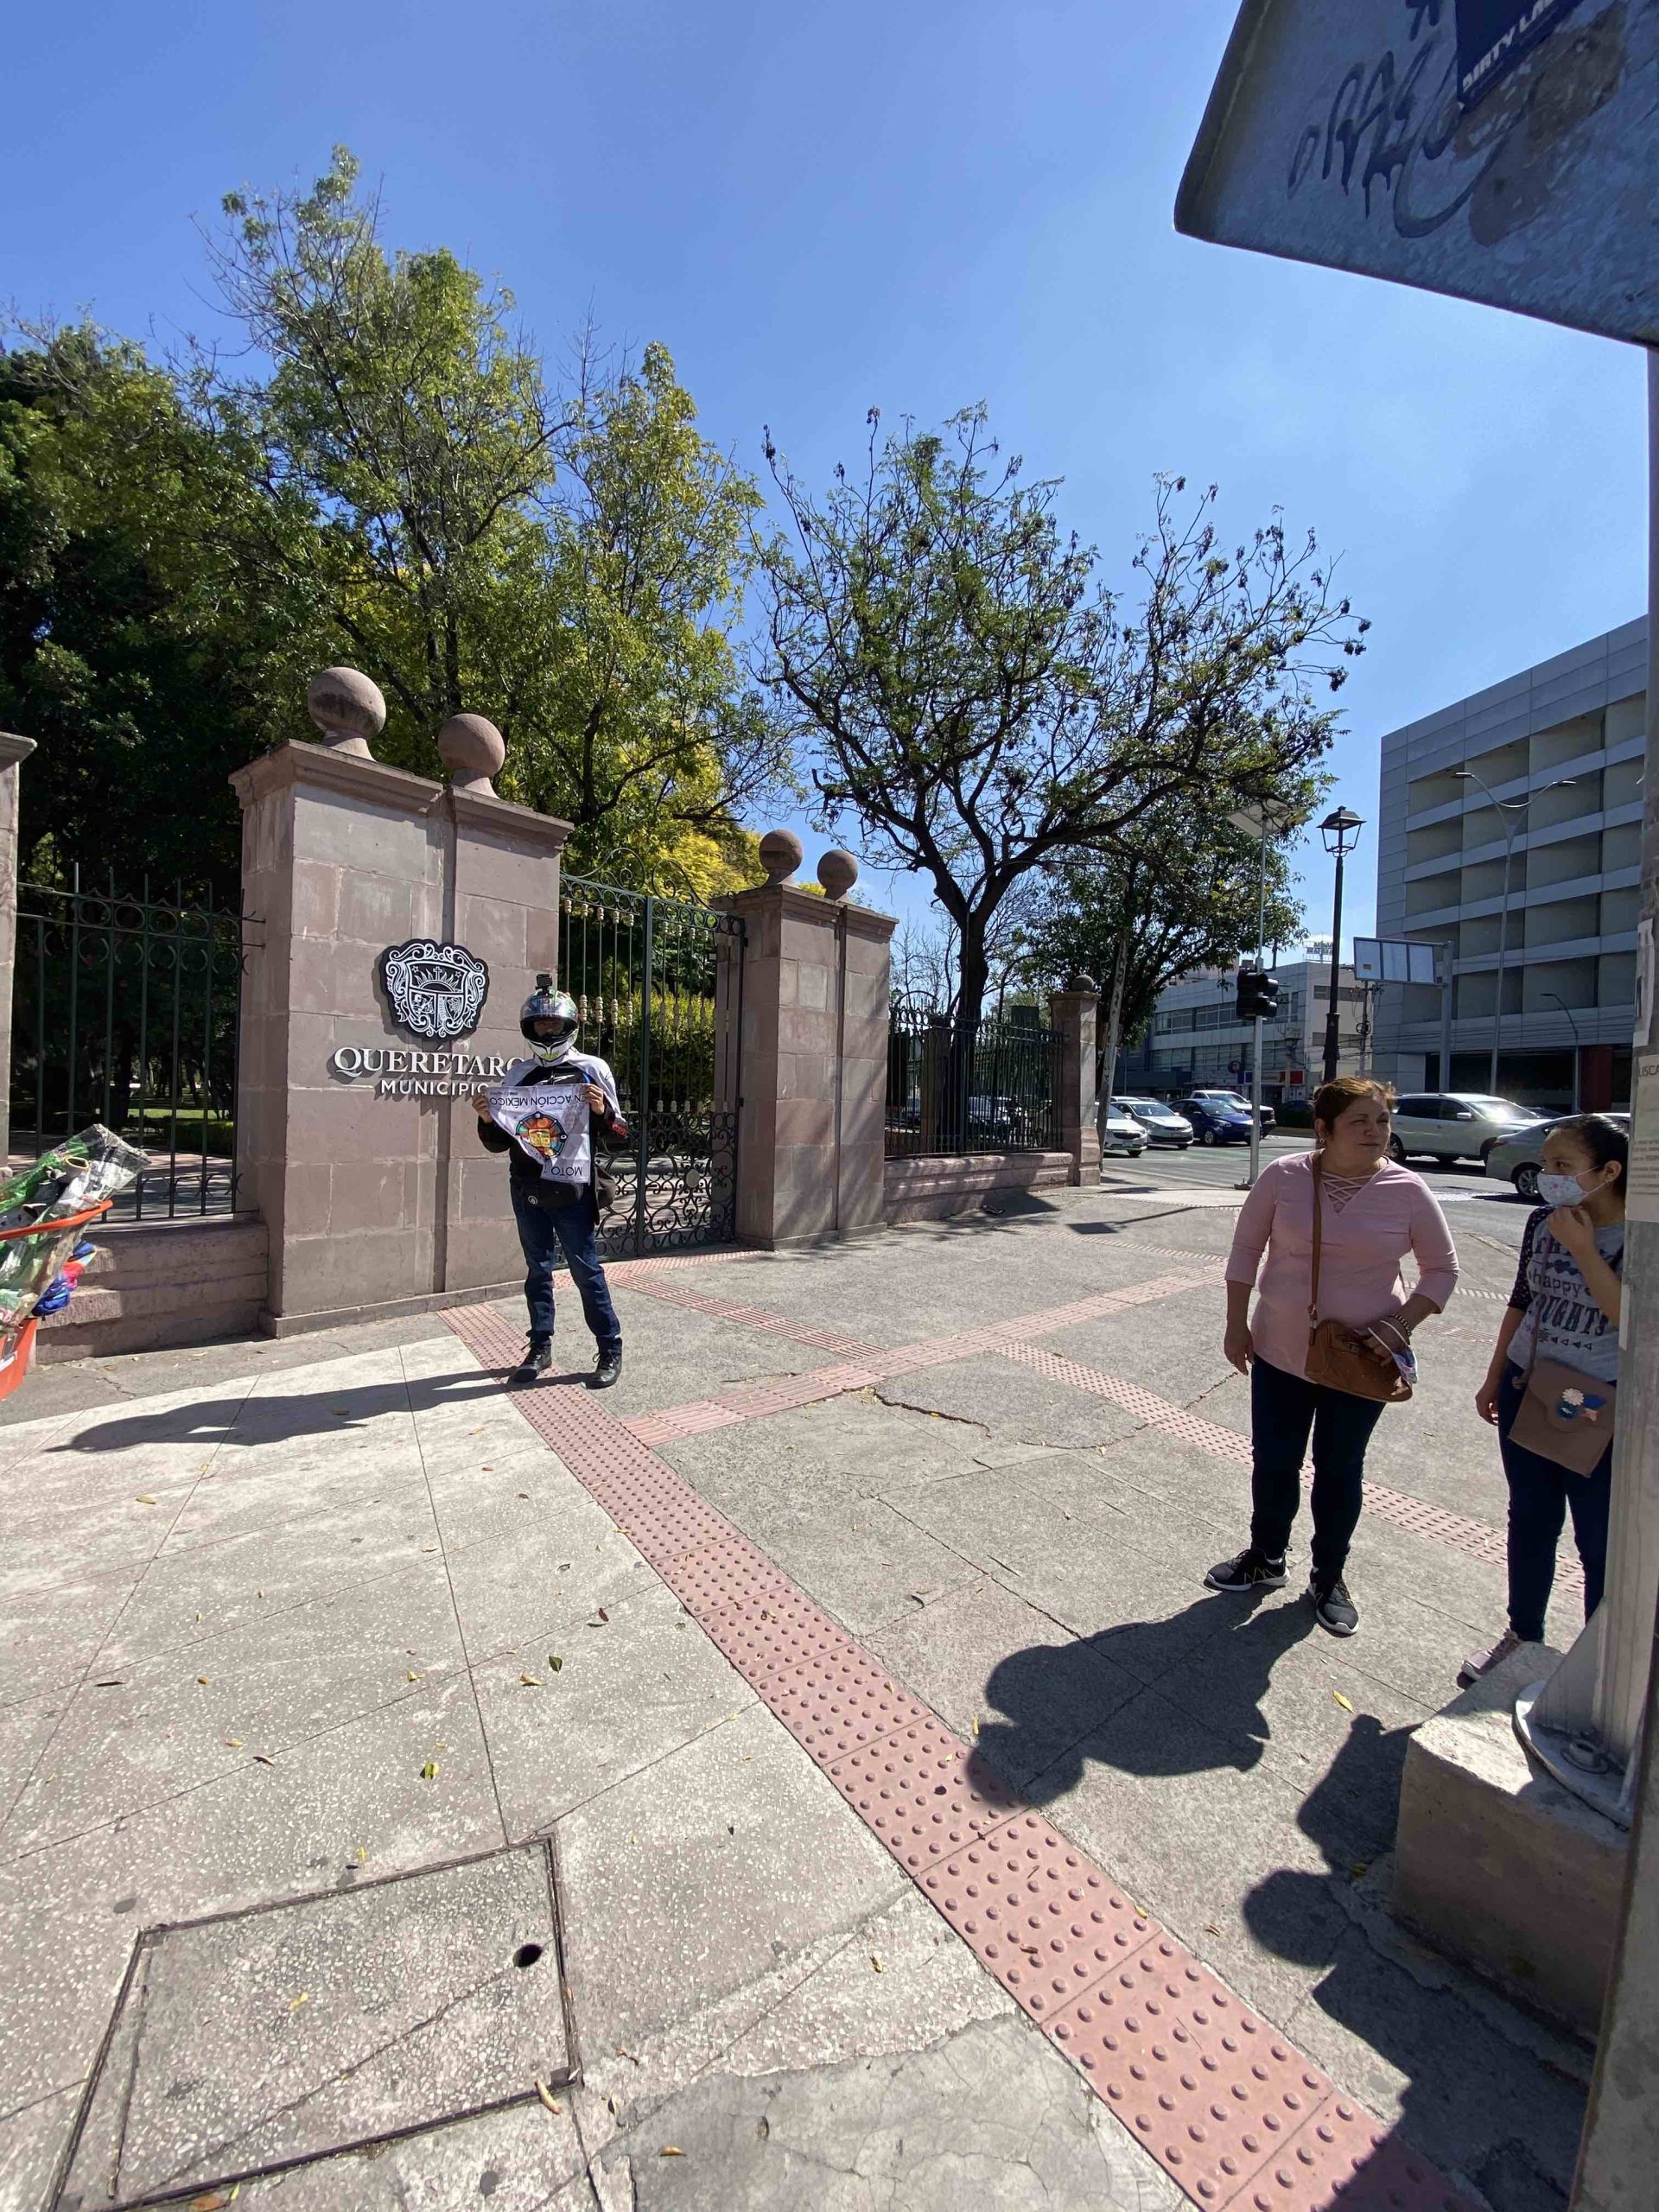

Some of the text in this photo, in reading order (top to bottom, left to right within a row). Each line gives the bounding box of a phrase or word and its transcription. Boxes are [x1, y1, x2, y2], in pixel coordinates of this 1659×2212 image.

[1462, 24, 1516, 92] DIRTY
[489, 1096, 528, 1109] MÉXICO
[531, 1095, 572, 1109] ACCIÓN
[550, 1166, 582, 1176] MOTO
